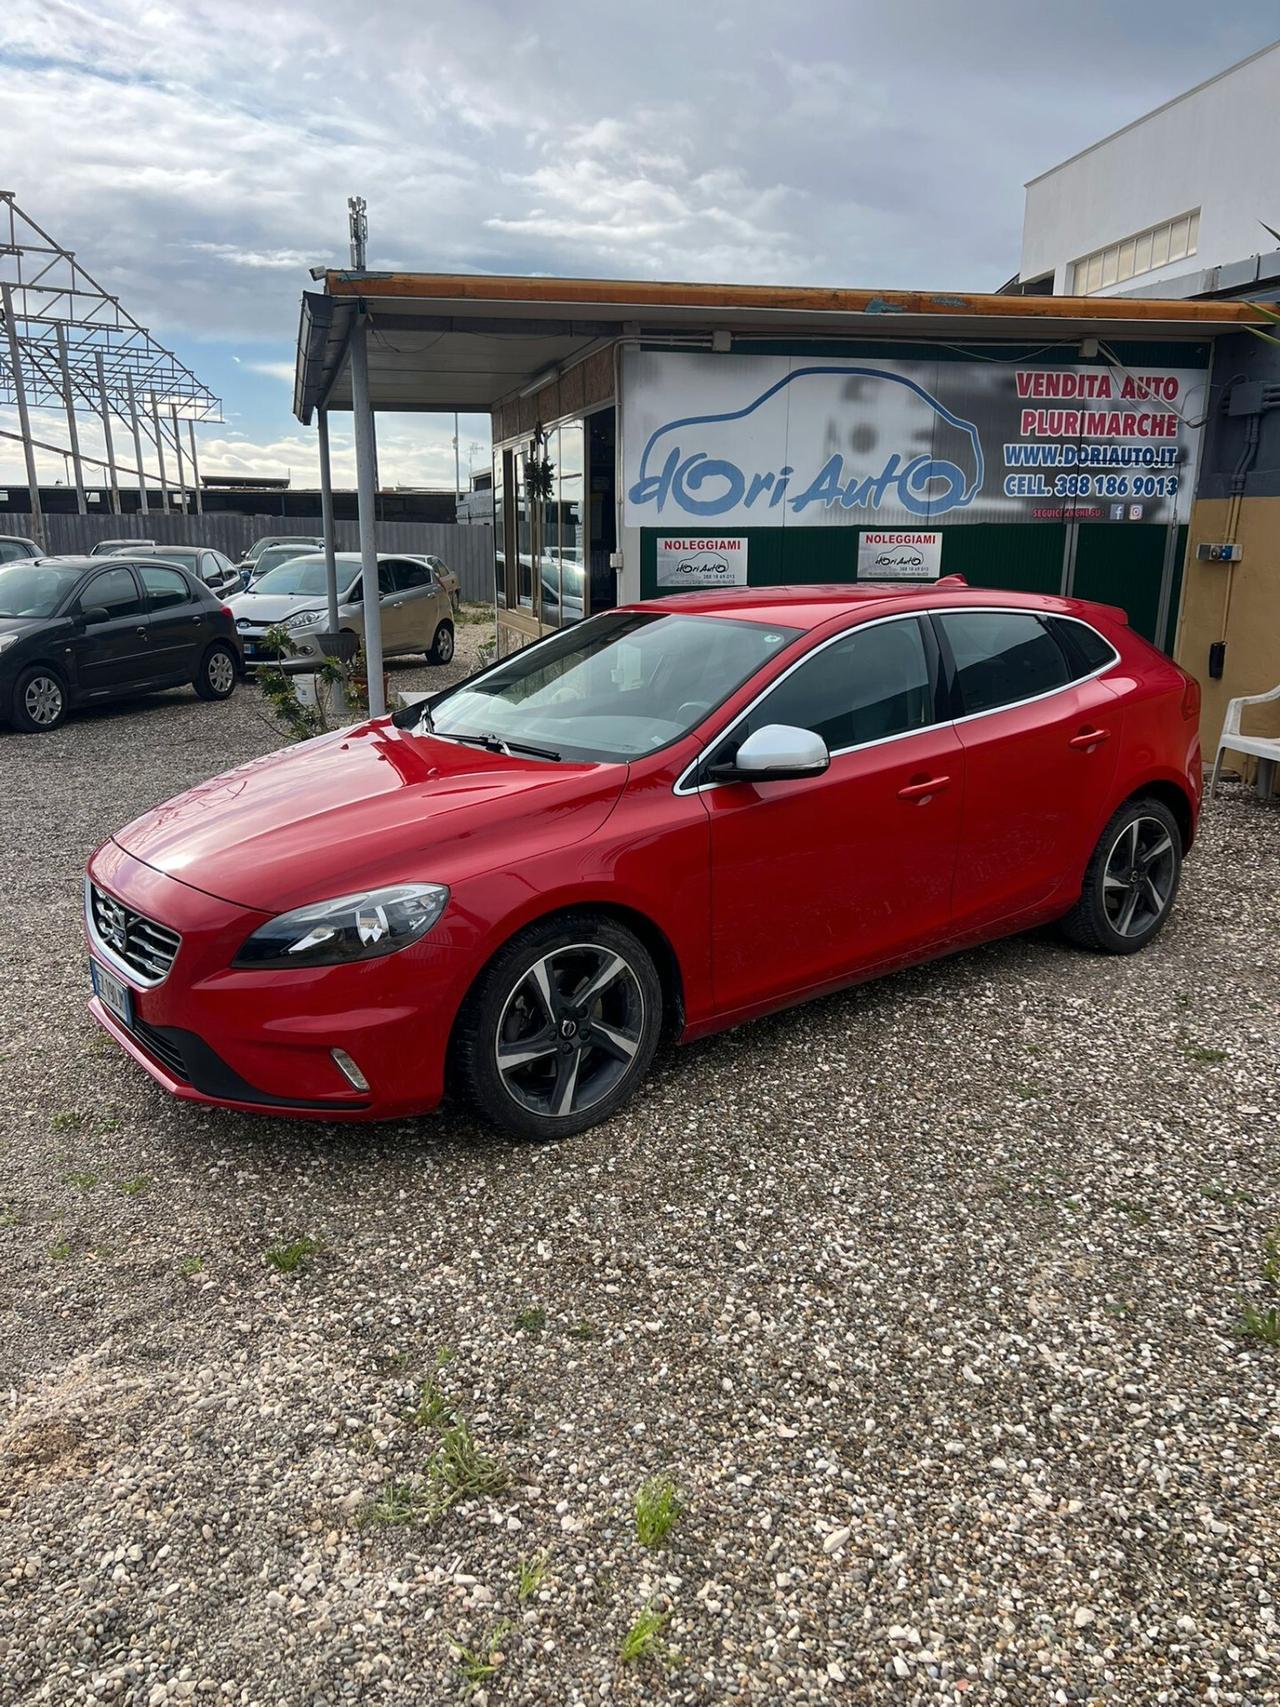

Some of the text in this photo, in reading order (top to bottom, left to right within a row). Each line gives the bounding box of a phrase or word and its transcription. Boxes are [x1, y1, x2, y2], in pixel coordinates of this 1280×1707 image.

[1015, 370, 1180, 401] VENDITA AUTO
[1020, 408, 1179, 438] PLURIMARCHE
[1003, 444, 1178, 468] WWW.DORIAUTO.IT
[1004, 473, 1178, 497] CELL. 388 186 9013
[664, 540, 741, 550] NOLEGGIAMI
[865, 534, 936, 544] NOLEGGIAMI
